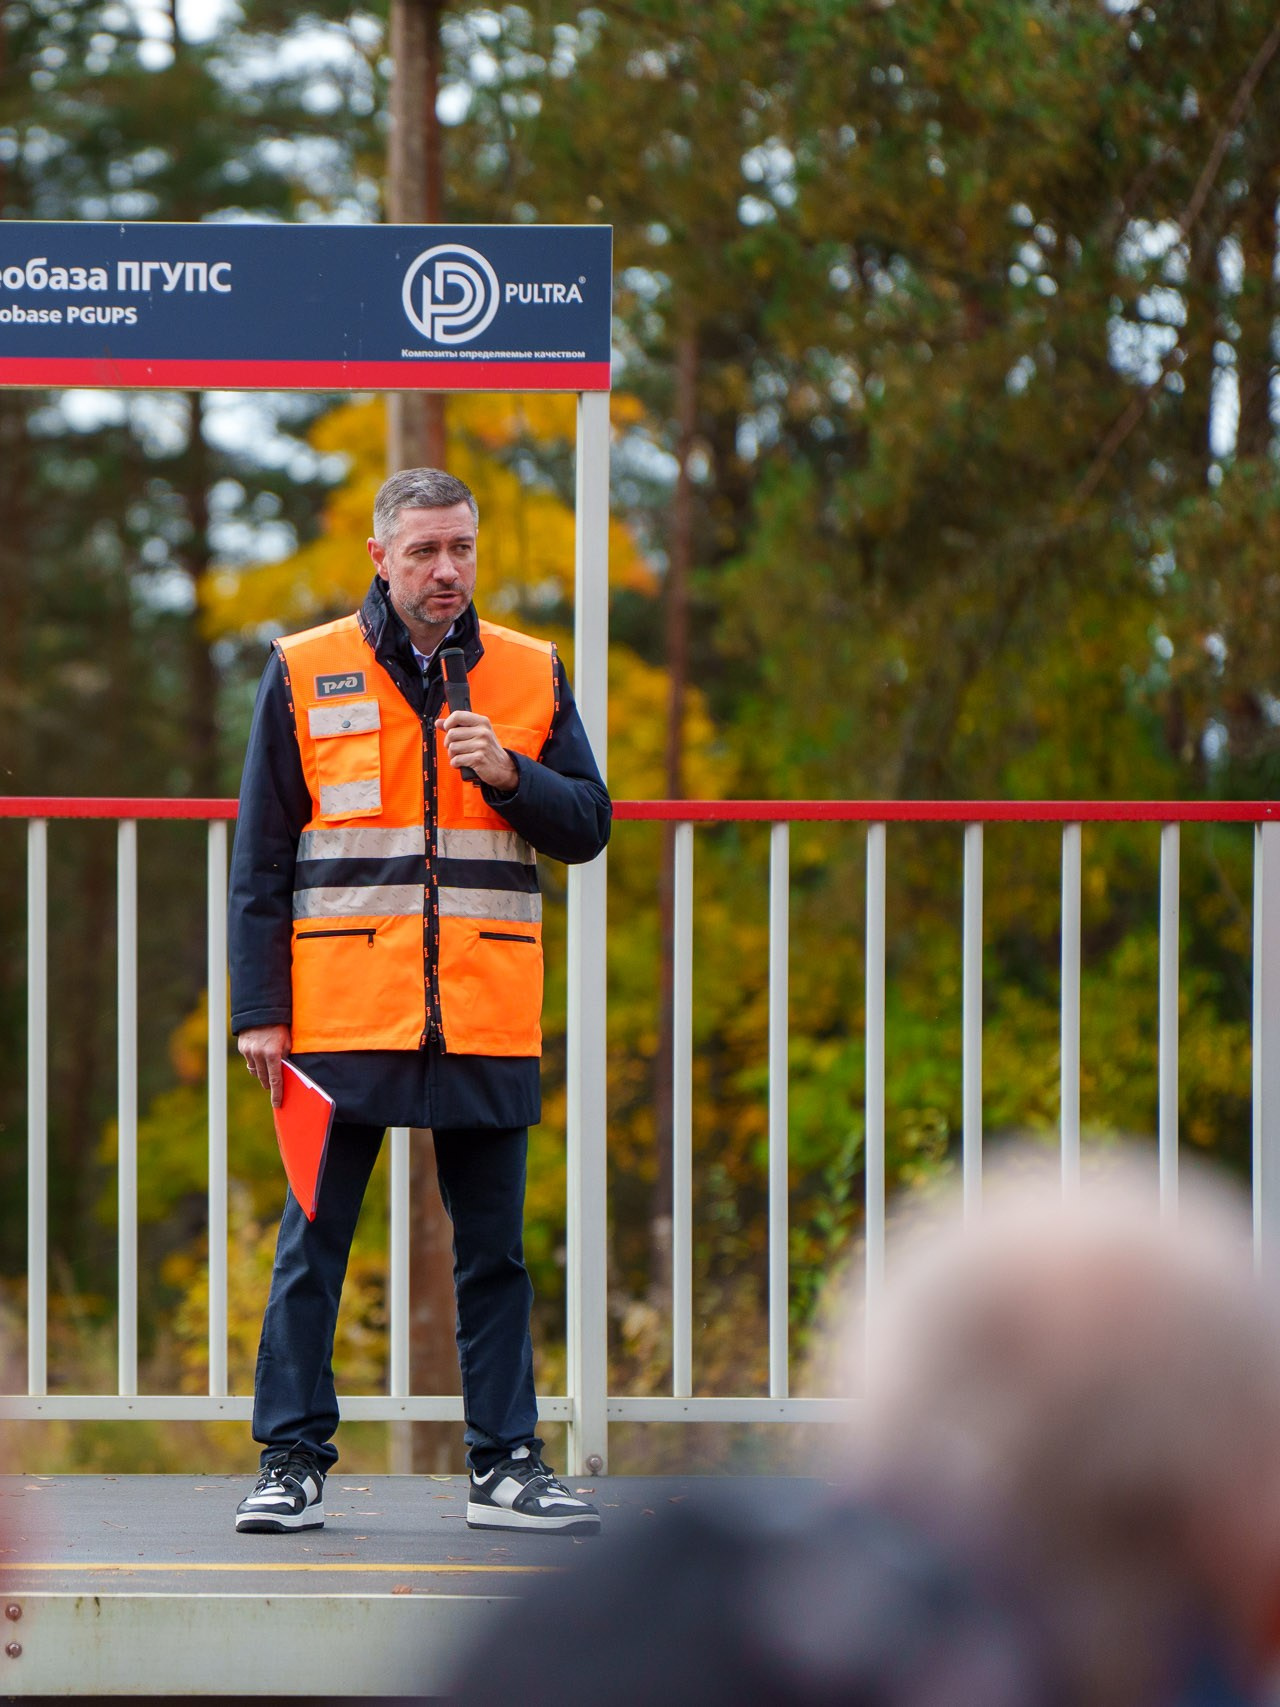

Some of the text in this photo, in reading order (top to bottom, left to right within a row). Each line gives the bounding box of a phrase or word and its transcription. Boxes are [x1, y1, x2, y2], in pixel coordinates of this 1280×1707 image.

[117, 261, 232, 293] ПГУПС
[67, 306, 138, 325] PGUPS
[401, 348, 586, 359] Композиты определяемые качеством
